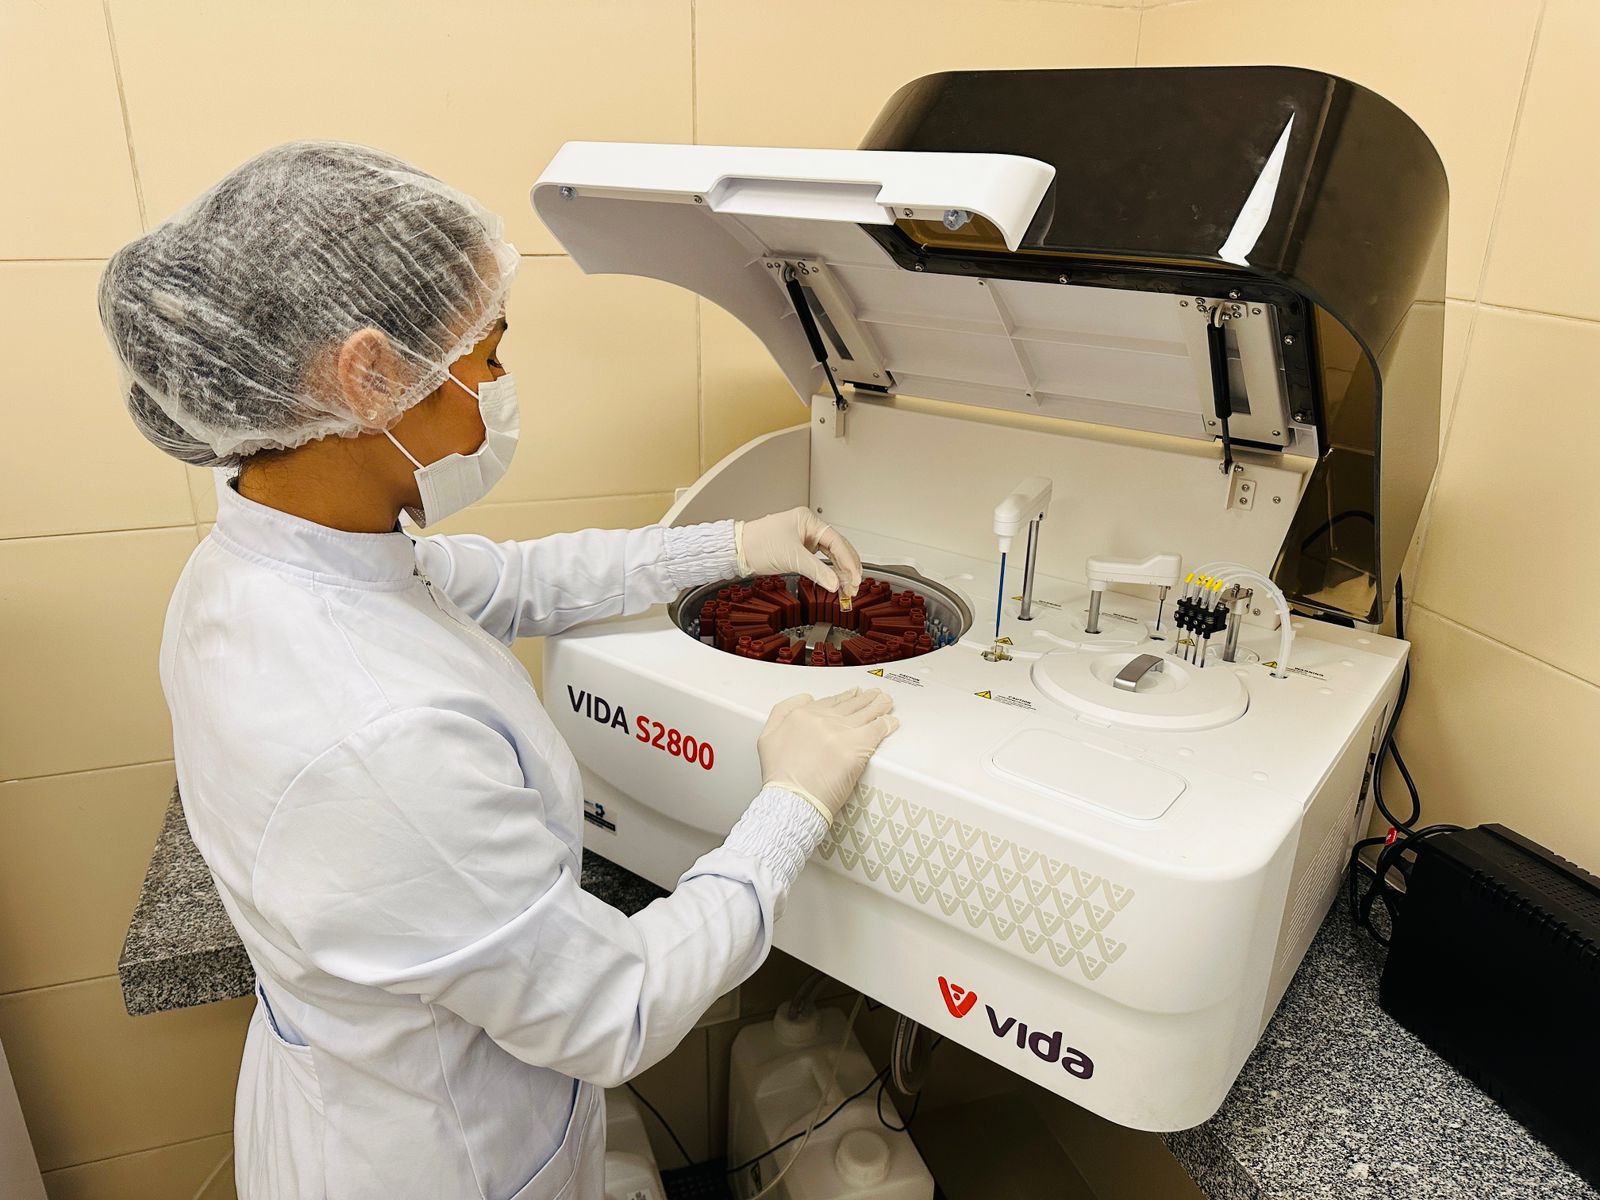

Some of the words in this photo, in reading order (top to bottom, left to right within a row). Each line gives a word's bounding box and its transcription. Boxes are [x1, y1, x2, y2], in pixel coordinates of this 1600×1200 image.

[567, 684, 630, 735] VIDA
[635, 715, 715, 771] S2800
[985, 1004, 1094, 1080] vida
